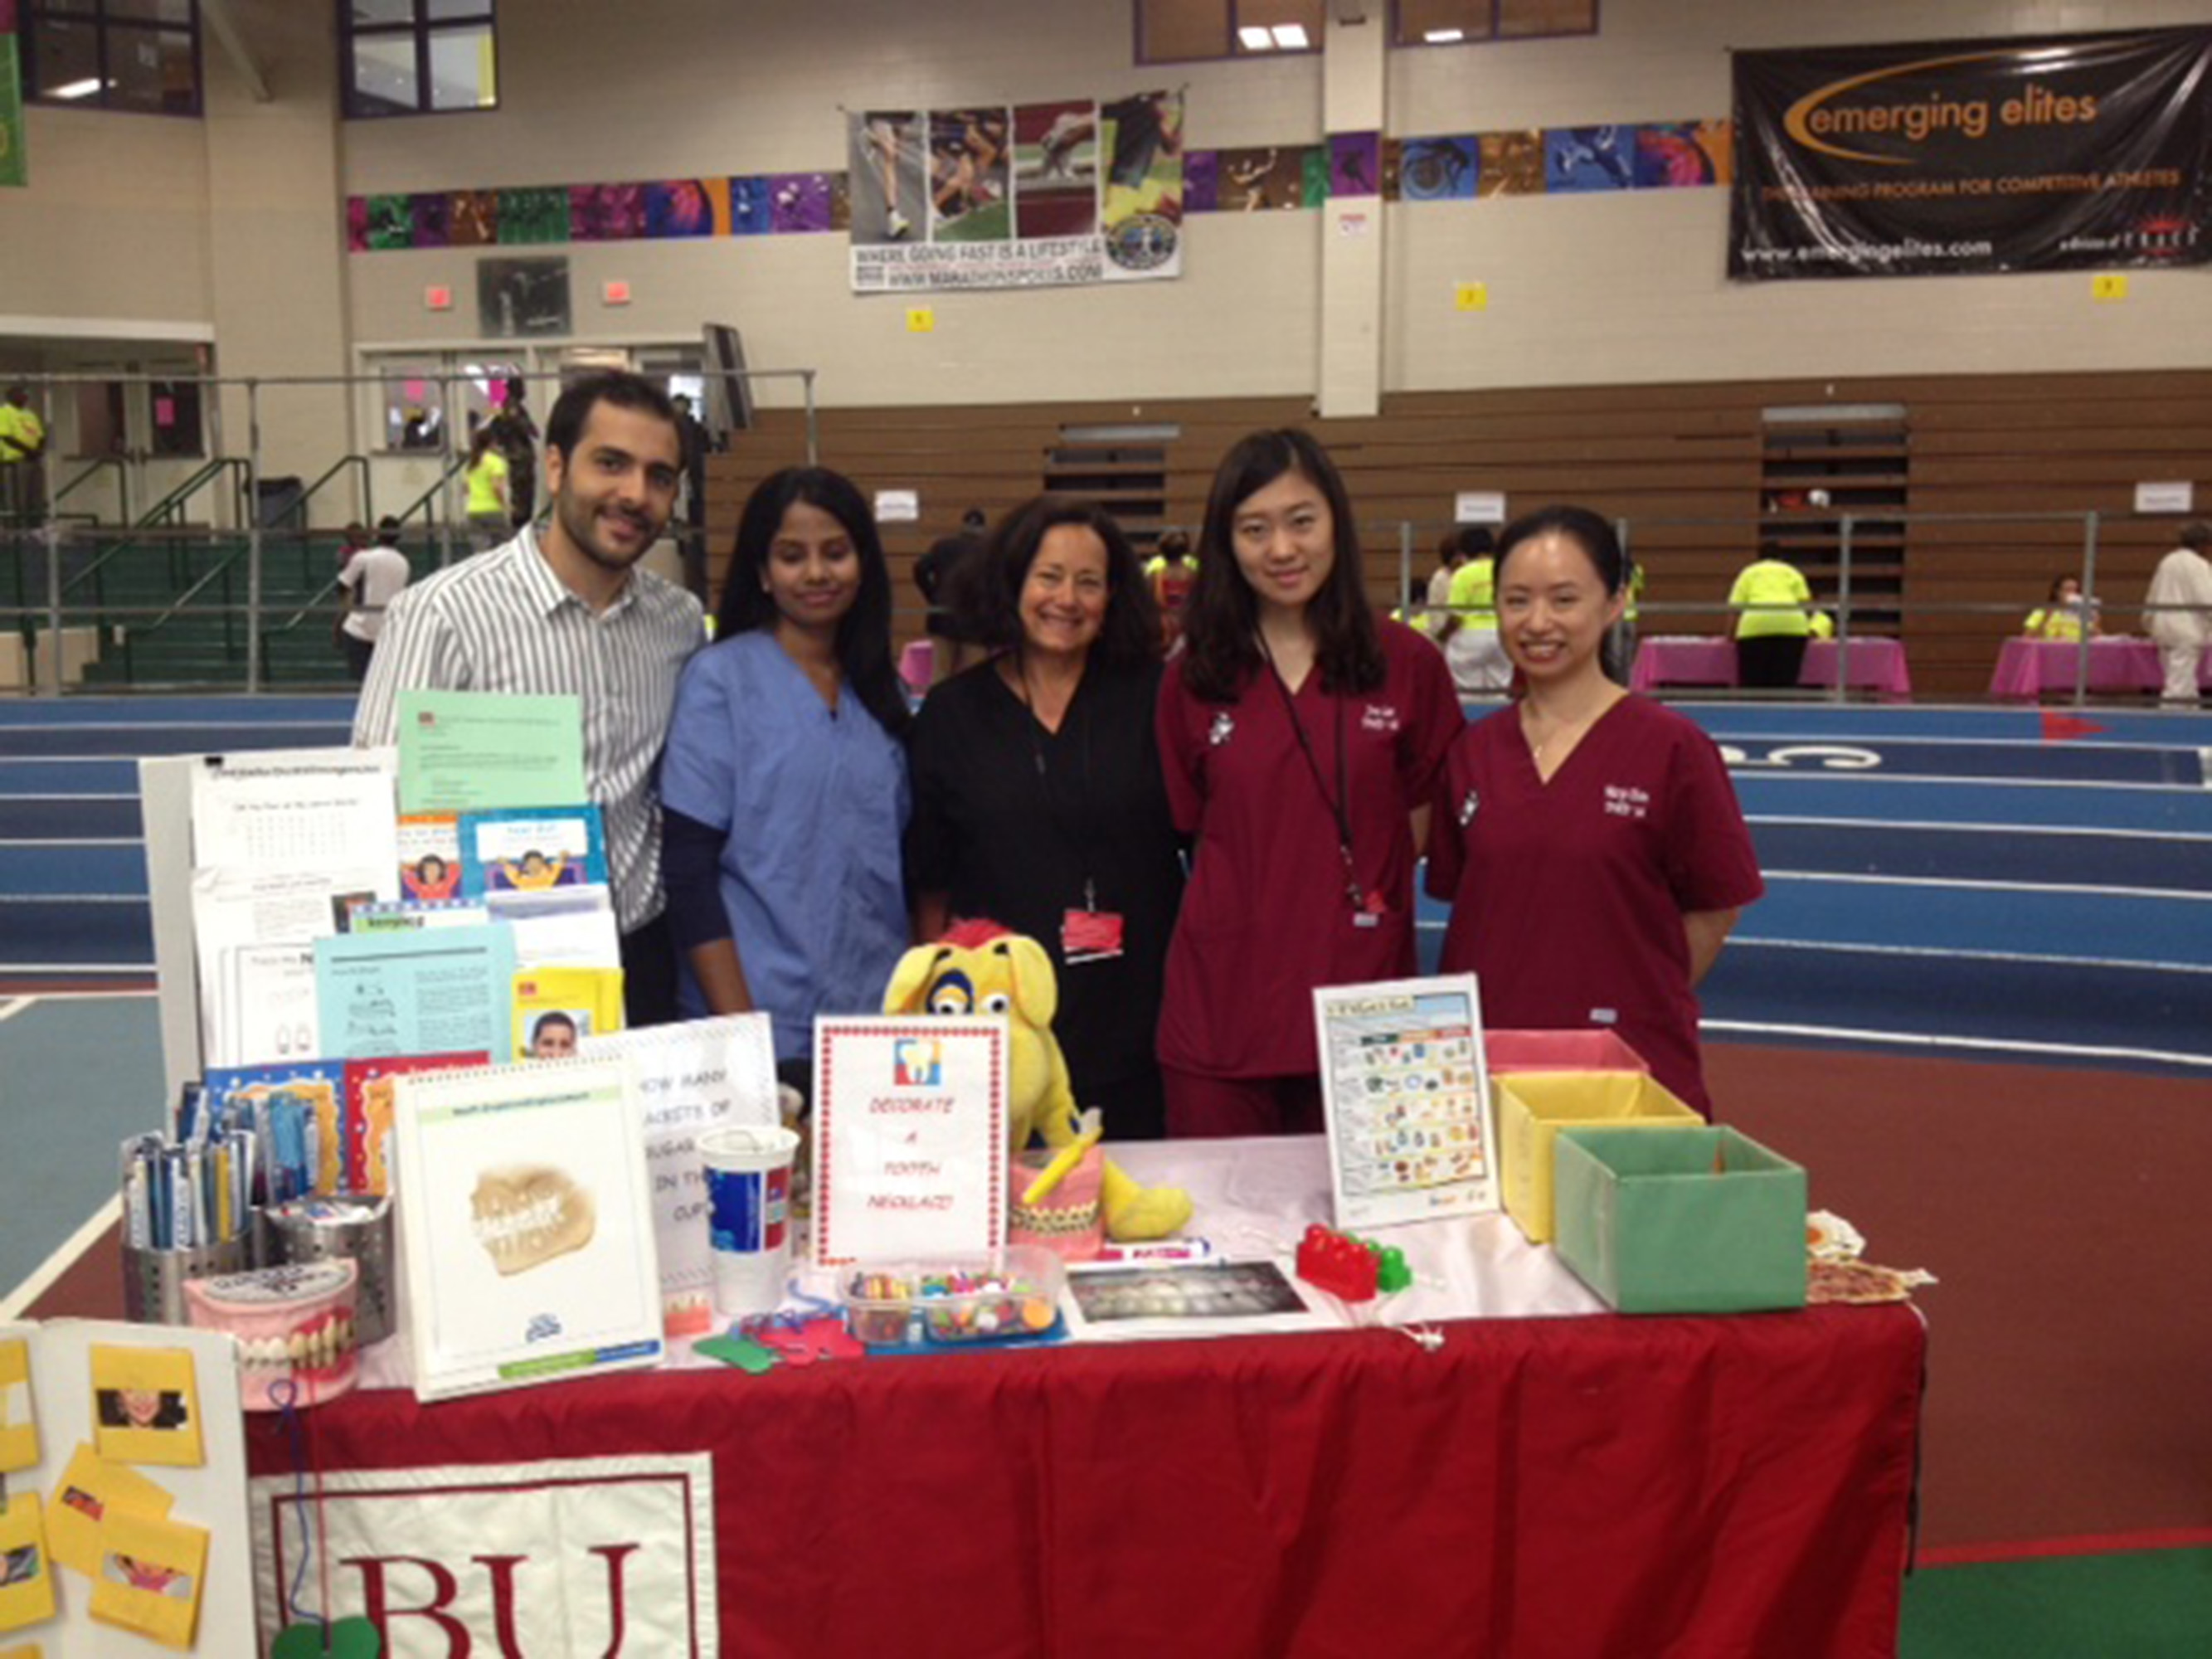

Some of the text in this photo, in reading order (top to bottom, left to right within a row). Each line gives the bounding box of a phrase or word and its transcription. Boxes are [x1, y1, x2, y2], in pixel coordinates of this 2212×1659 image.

[1810, 84, 2098, 139] emerging elites
[1872, 178, 1955, 199] PROGRAM
[1959, 177, 1991, 194] FOR
[1996, 173, 2102, 195] COMPETITIVE
[856, 249, 905, 263] WHERE
[910, 246, 955, 261] GOING
[960, 244, 995, 260] FAST
[998, 244, 1014, 259] IS
[1017, 242, 1026, 257] A
[1742, 236, 1992, 264] www.emergingelites.com
[681, 1069, 727, 1087] MANY
[710, 1098, 731, 1117] OF
[869, 1097, 955, 1114] DECORATE
[646, 1137, 695, 1159] SUGAR
[905, 1131, 917, 1144] A
[656, 1175, 678, 1191] IN
[338, 1543, 640, 1659] BU
